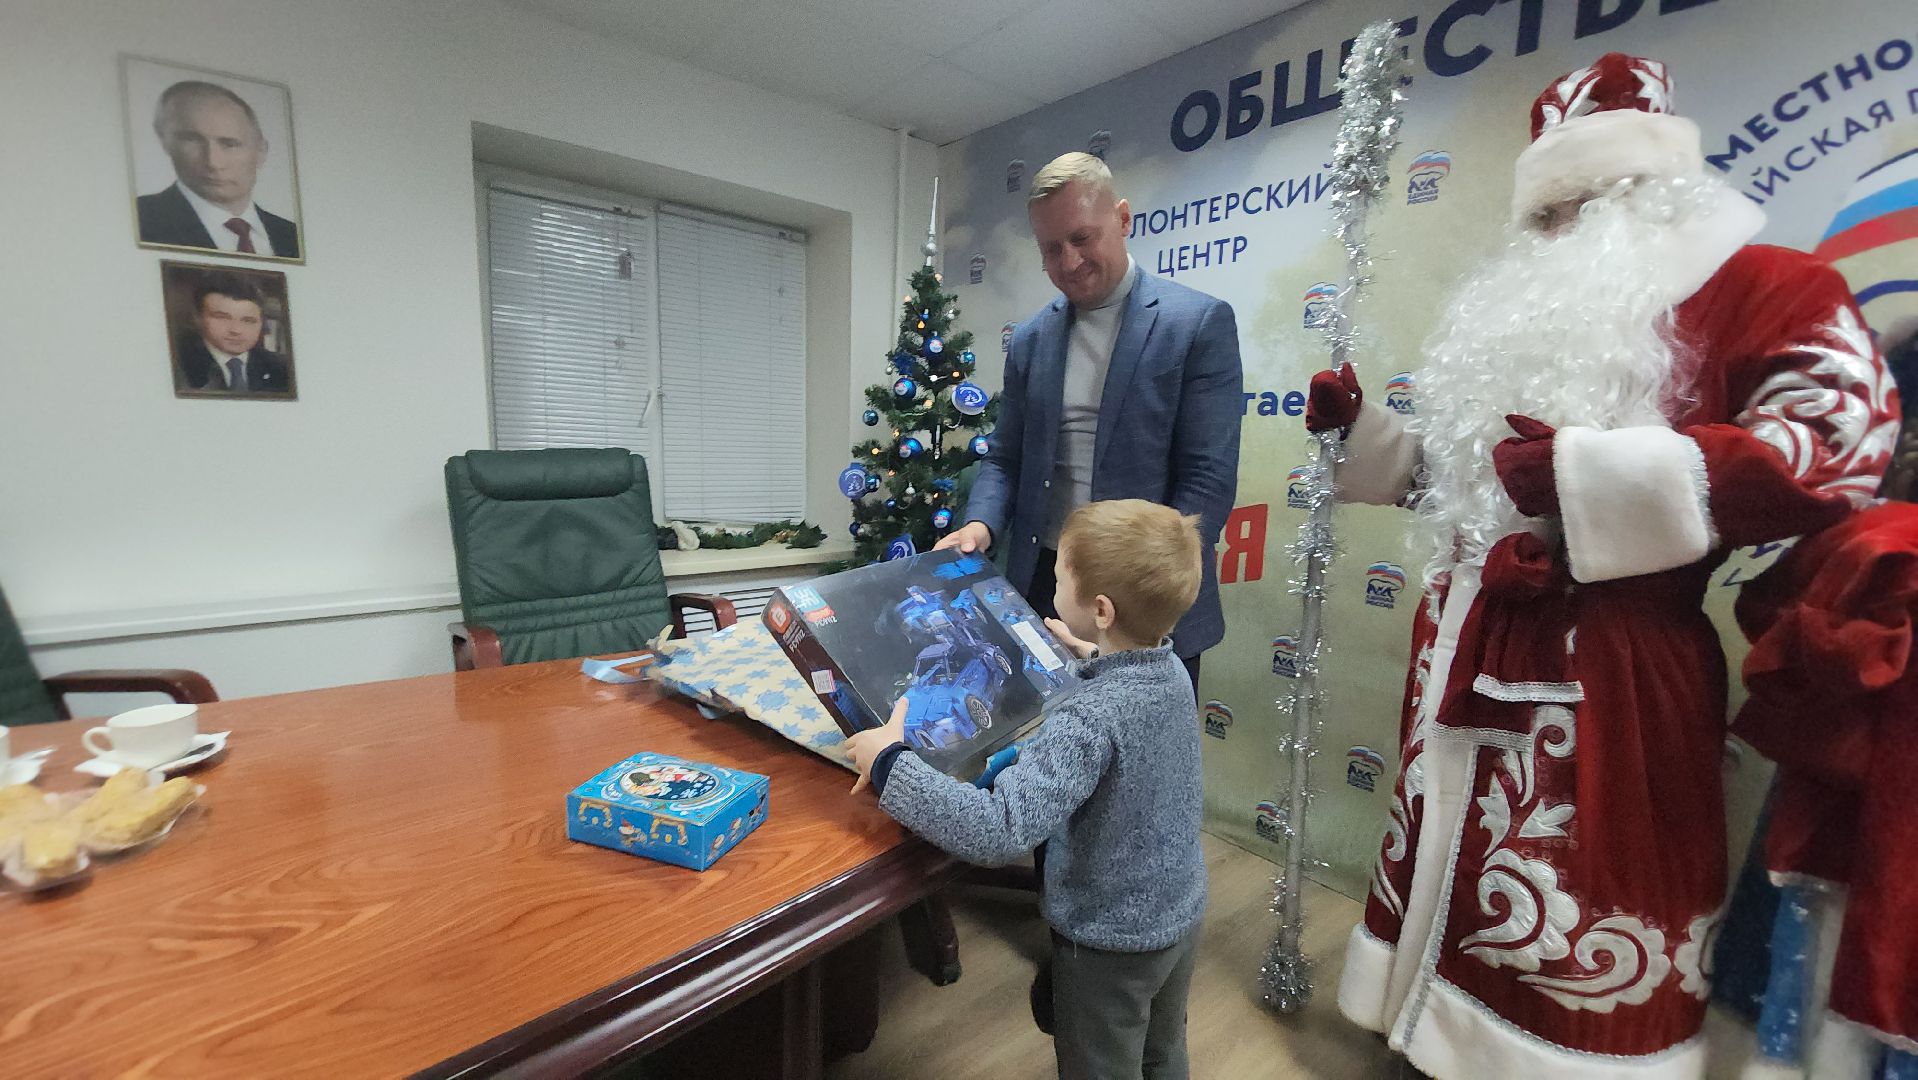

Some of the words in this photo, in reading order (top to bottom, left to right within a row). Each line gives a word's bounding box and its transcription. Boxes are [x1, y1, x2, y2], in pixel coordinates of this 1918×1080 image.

[1704, 38, 1918, 173] МЕСТНО
[1157, 235, 1248, 278] ЦЕНТР
[1215, 503, 1269, 585] Я
